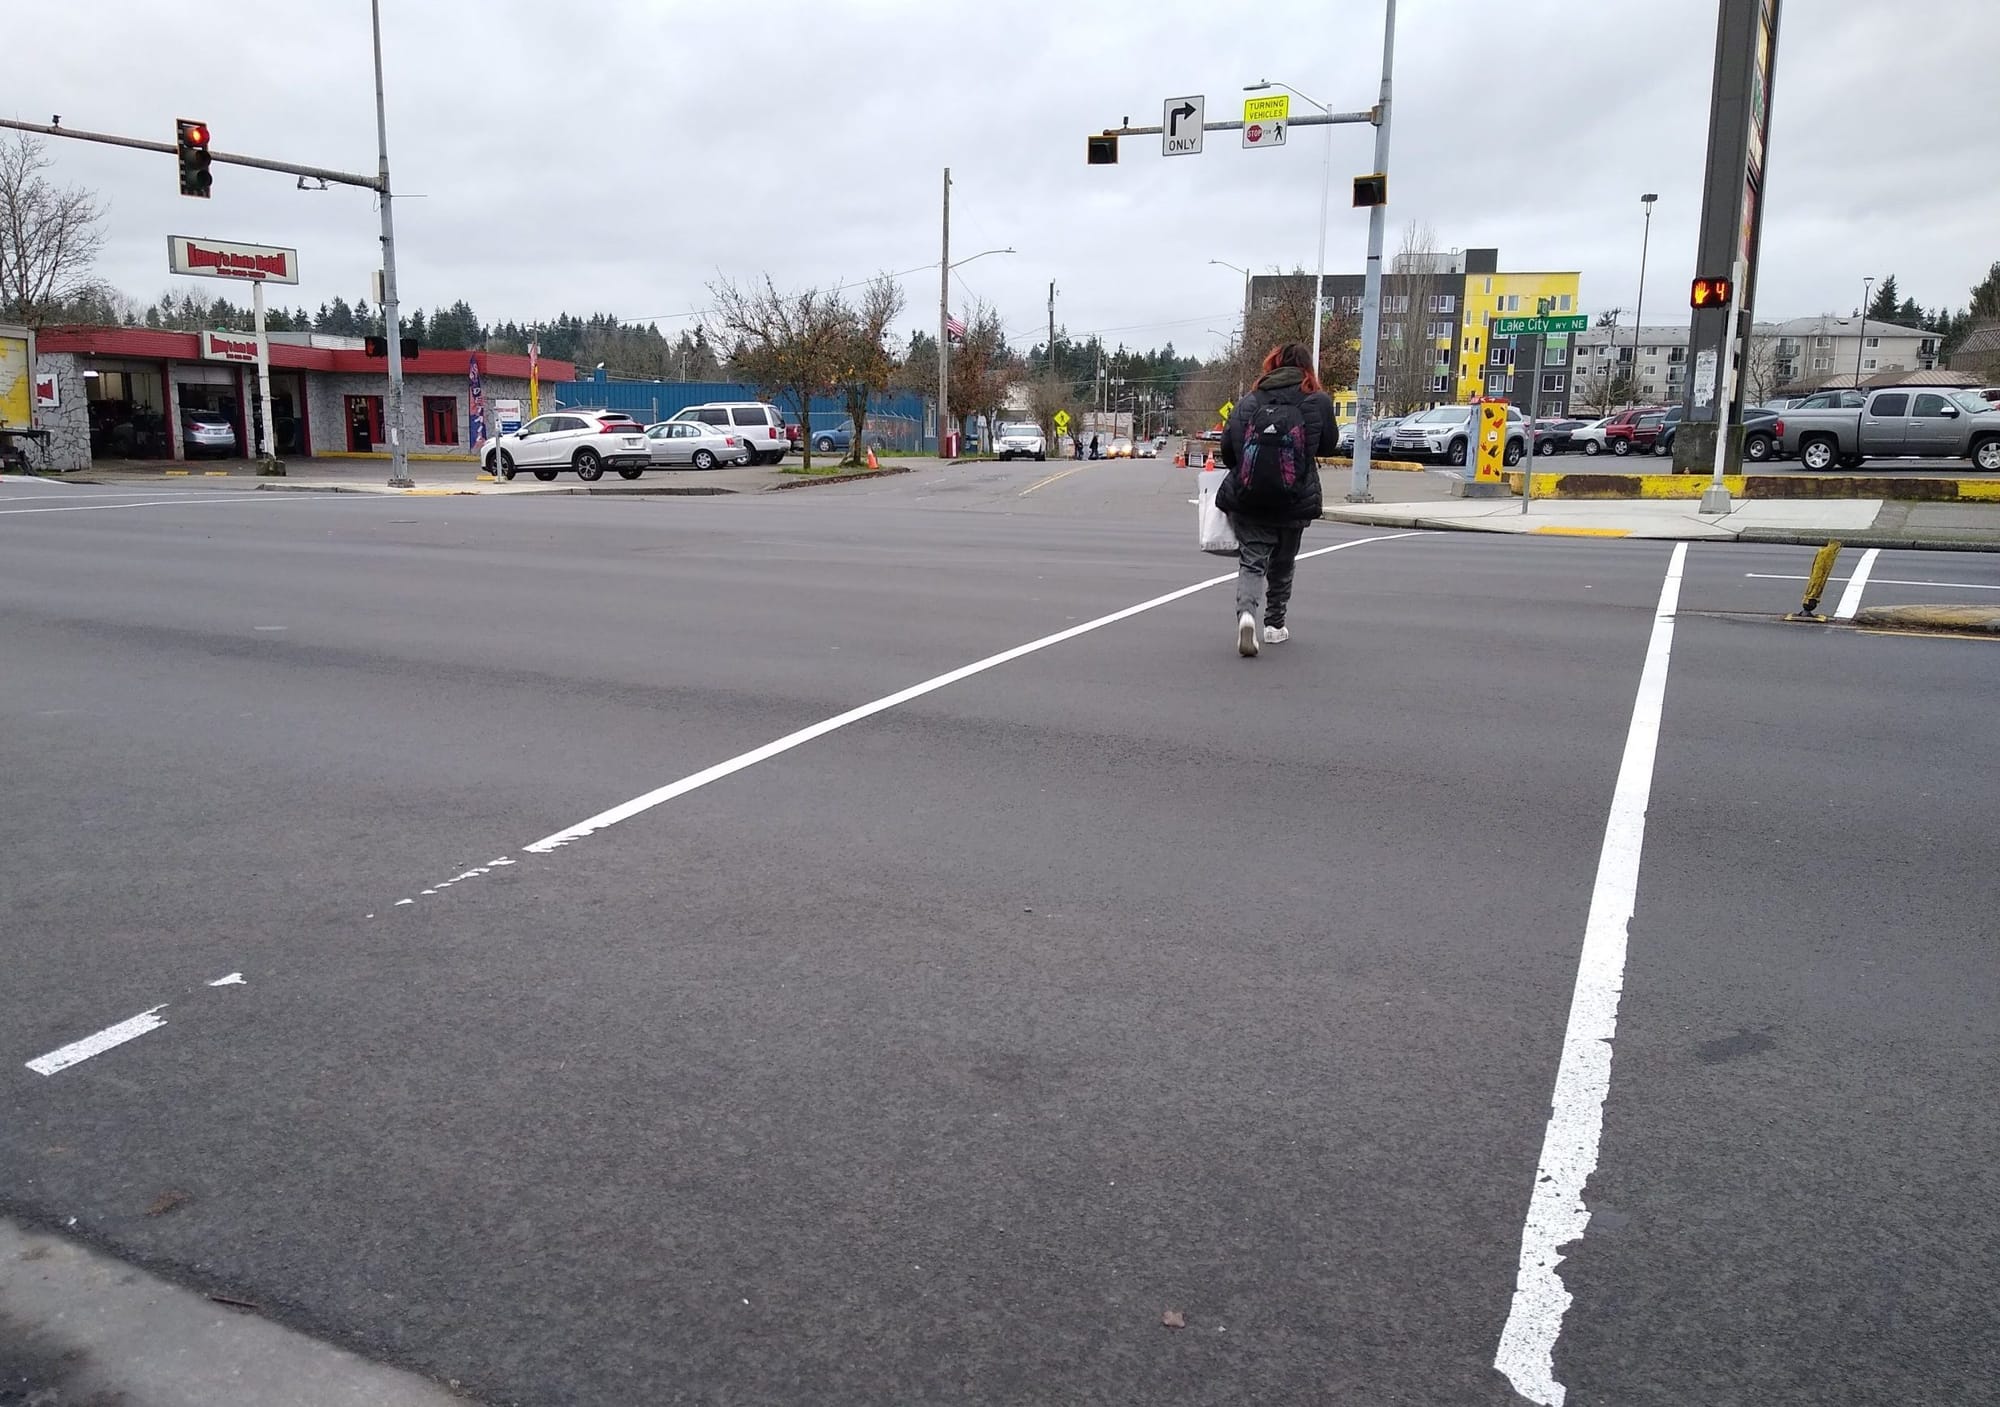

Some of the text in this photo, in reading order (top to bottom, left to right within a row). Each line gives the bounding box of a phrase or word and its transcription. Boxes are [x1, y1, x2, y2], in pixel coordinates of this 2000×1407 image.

[1249, 100, 1284, 111] TURNING
[1249, 109, 1283, 120] VEHICLES
[1247, 129, 1262, 138] STOP
[1169, 138, 1196, 151] ONLY
[1716, 282, 1725, 302] 4
[1500, 319, 1525, 332] Lake
[1527, 318, 1550, 332] City
[1571, 319, 1585, 329] NE
